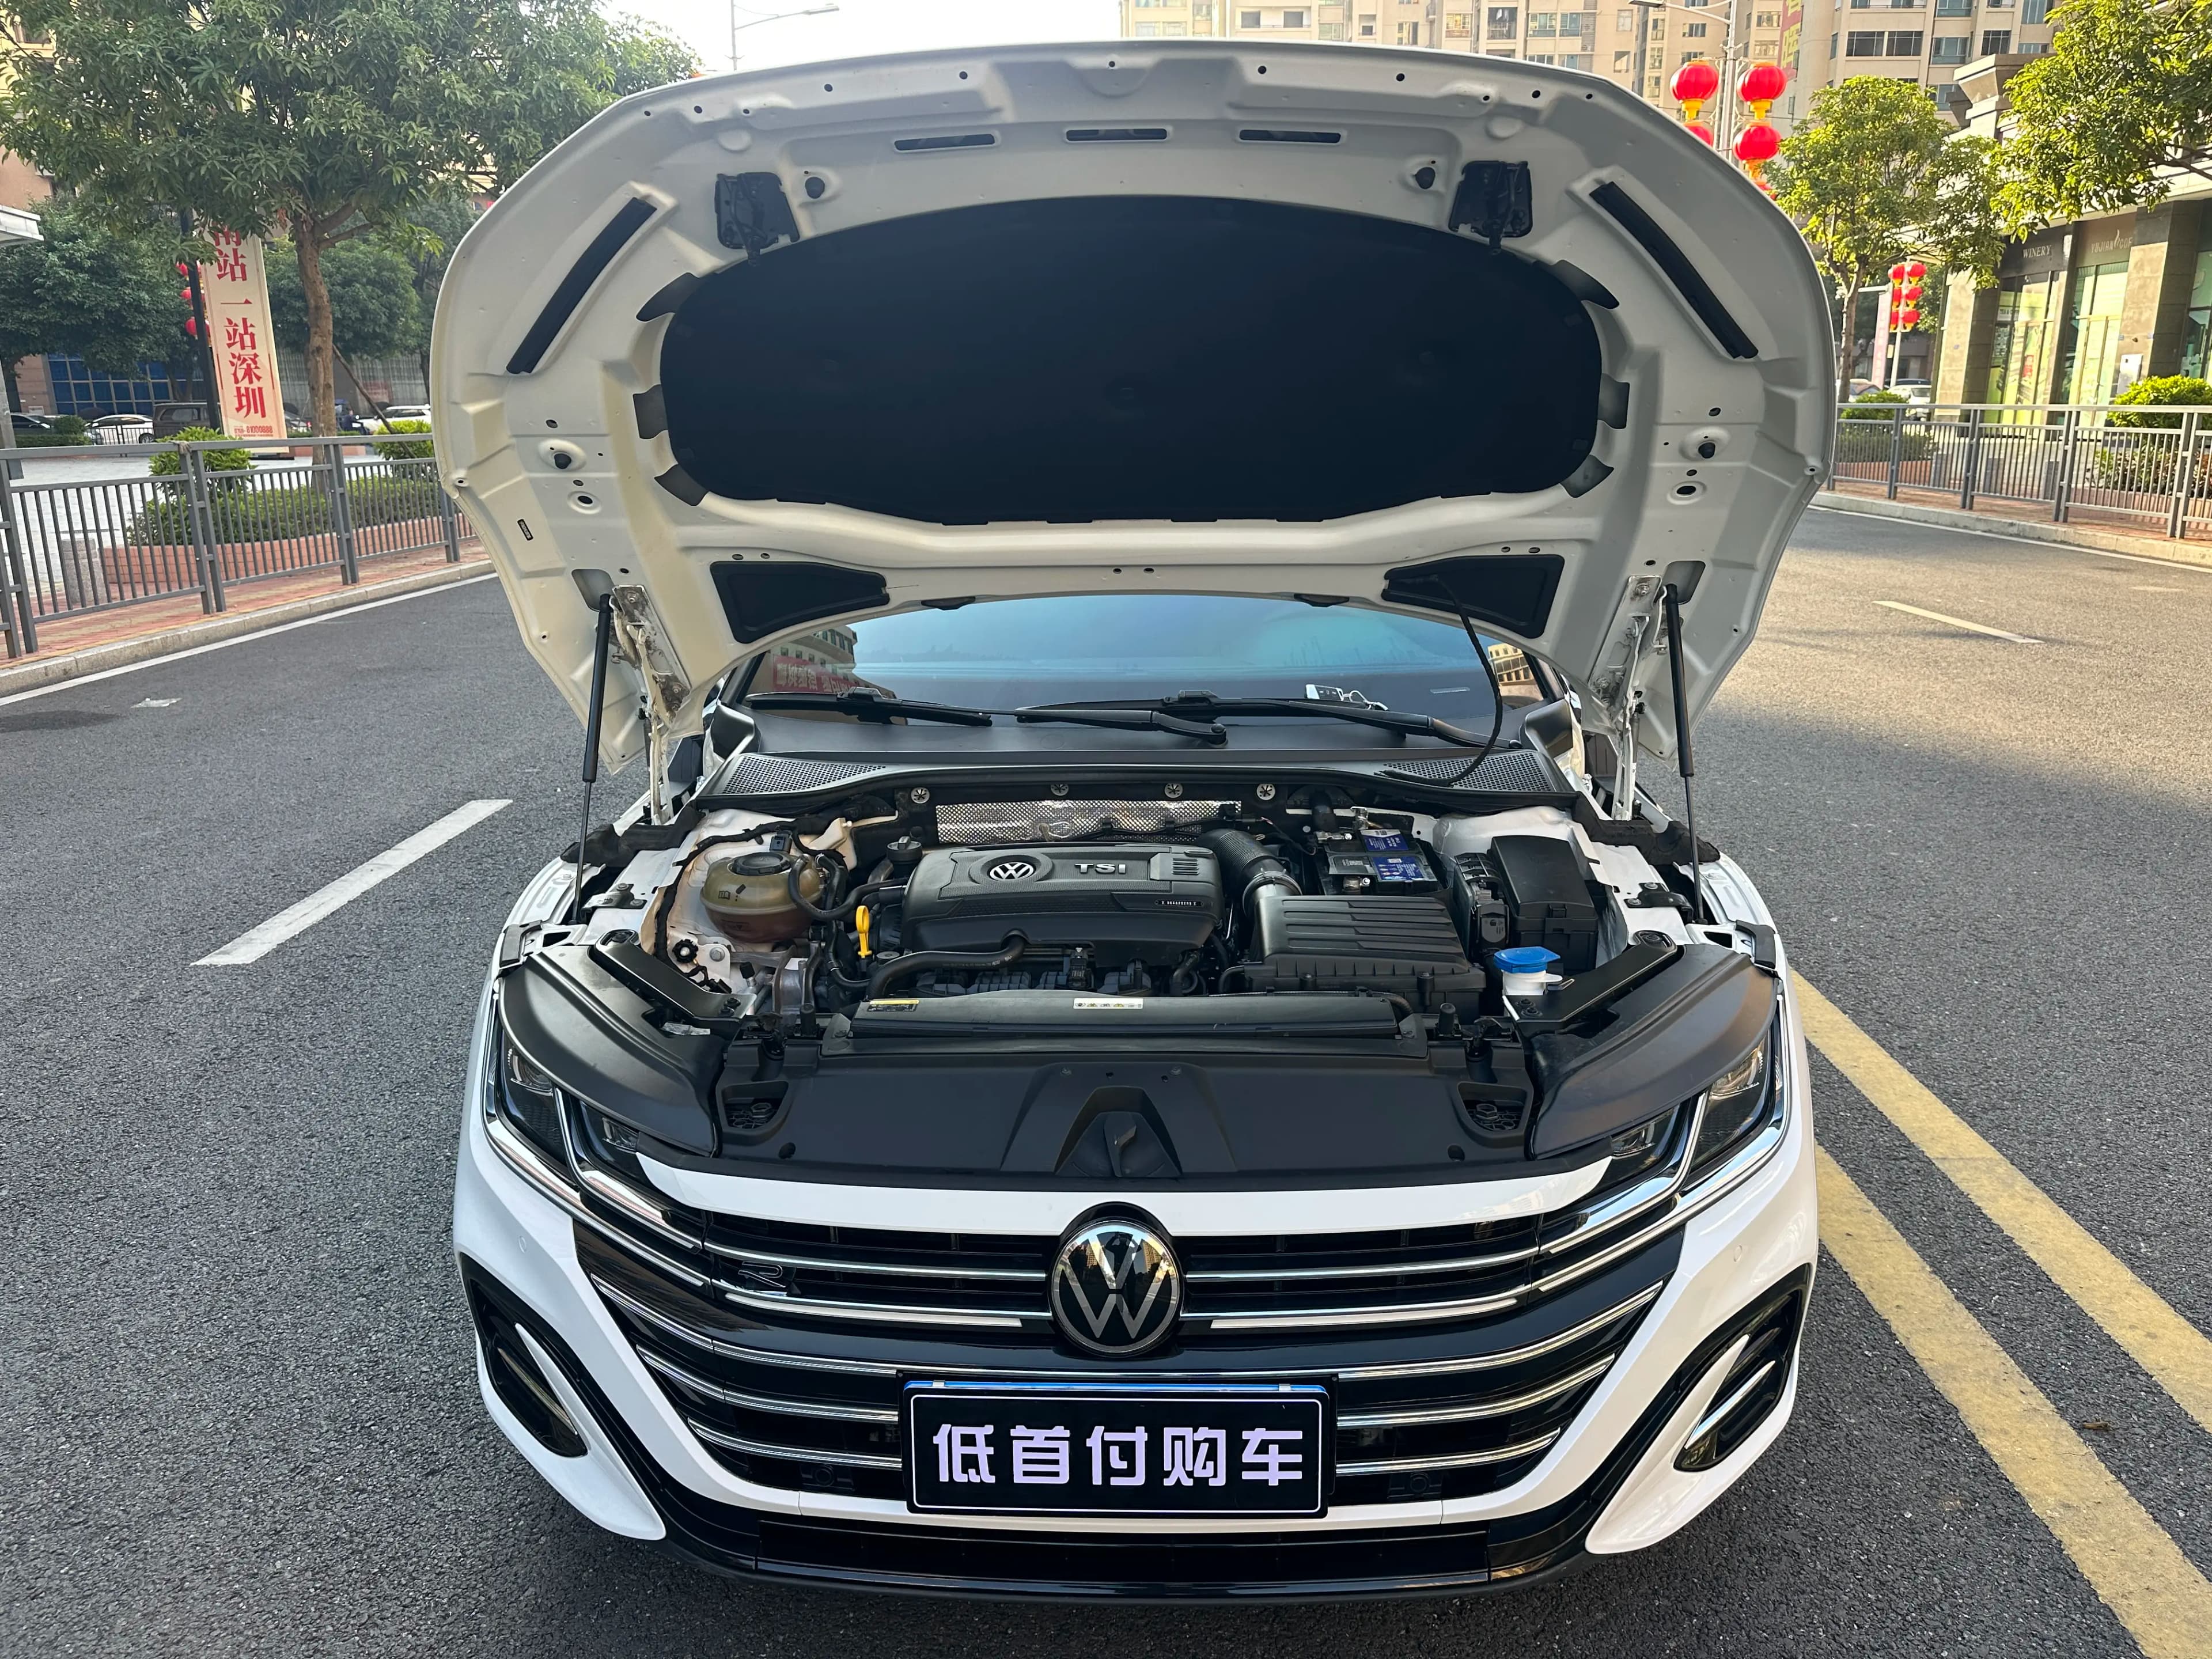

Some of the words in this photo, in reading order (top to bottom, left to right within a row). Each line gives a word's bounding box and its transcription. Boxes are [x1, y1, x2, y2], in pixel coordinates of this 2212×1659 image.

[2023, 244, 2052, 259] WINERY
[1075, 863, 1126, 873] TSI
[933, 1424, 1302, 1486] 低首付购车
